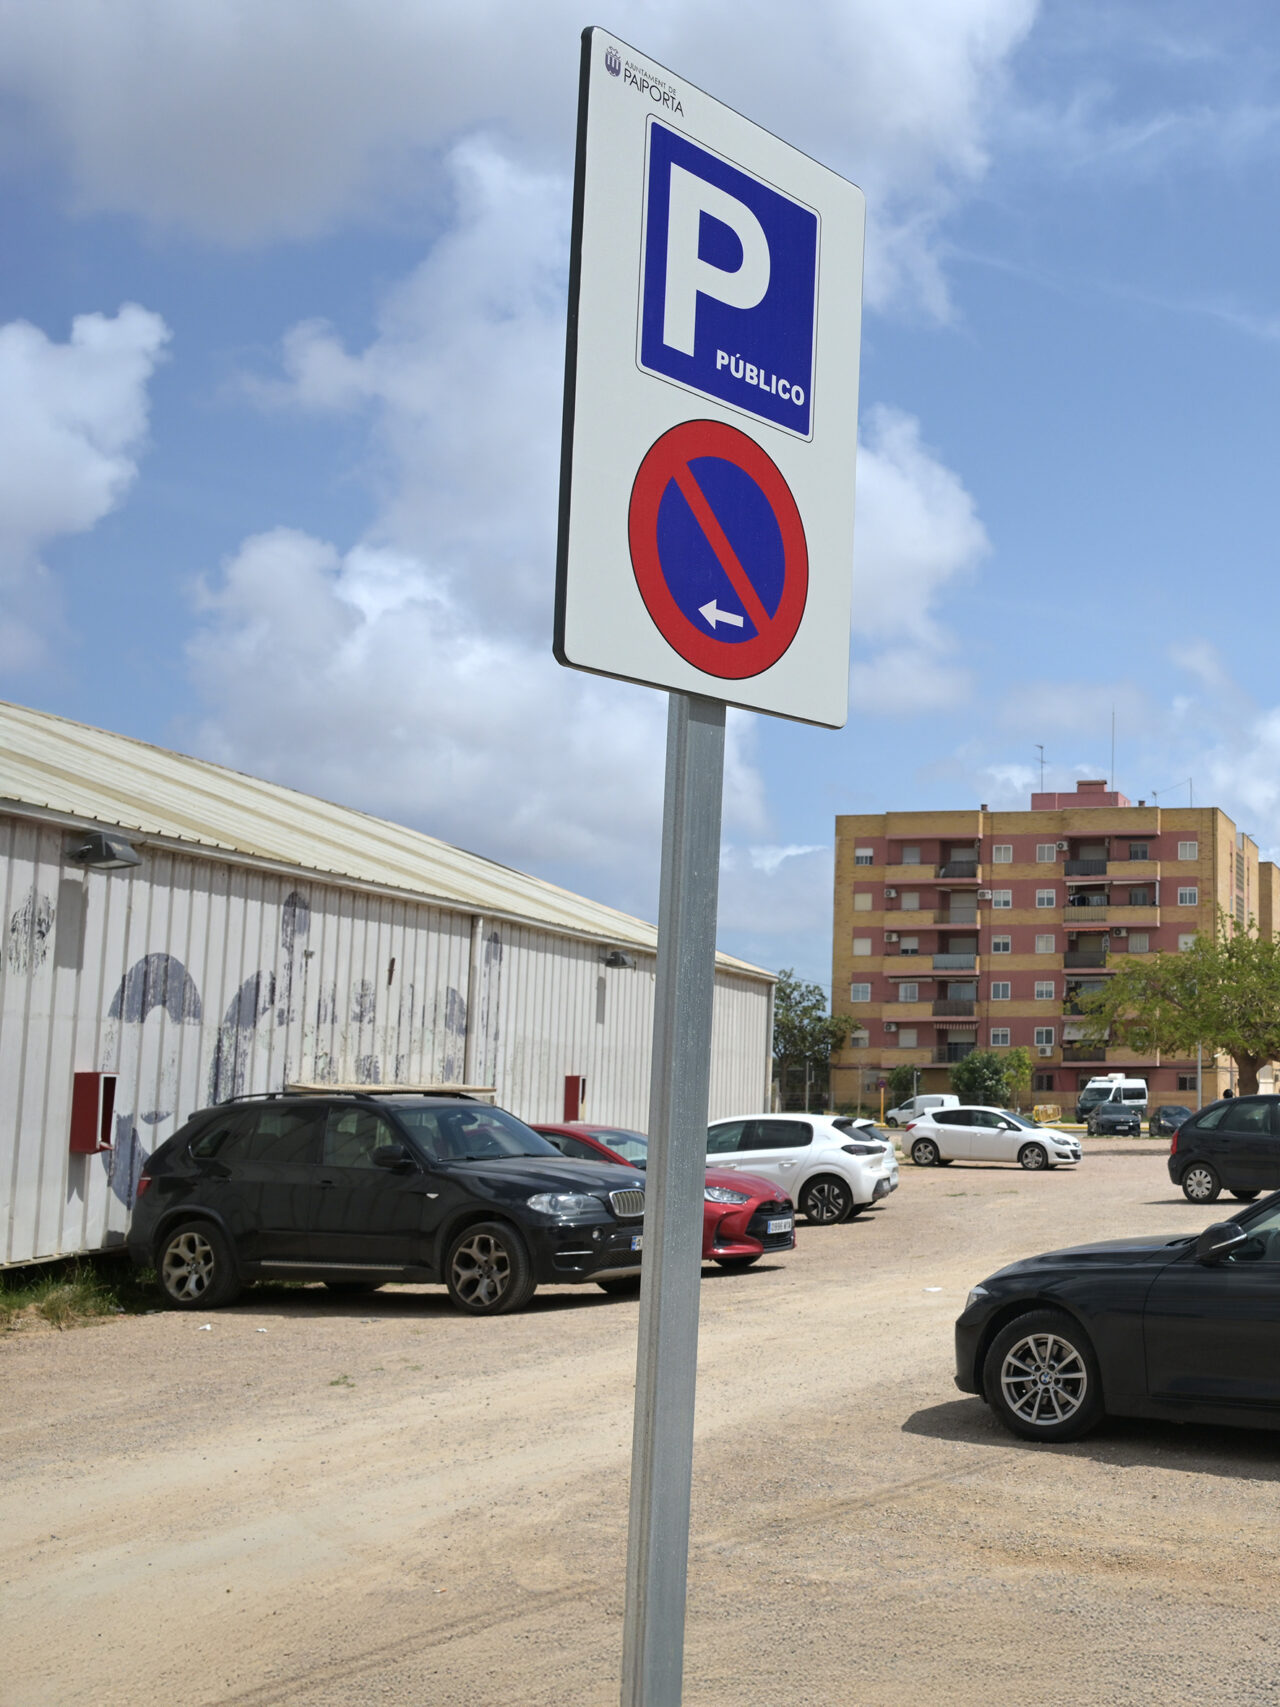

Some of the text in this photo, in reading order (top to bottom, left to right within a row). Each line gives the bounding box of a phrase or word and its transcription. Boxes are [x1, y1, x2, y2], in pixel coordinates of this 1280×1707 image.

[623, 67, 684, 117] PAIPORTA
[625, 60, 677, 96] AJUNTAMENT DE
[663, 161, 771, 357] P
[716, 349, 805, 406] PÚBLICO
